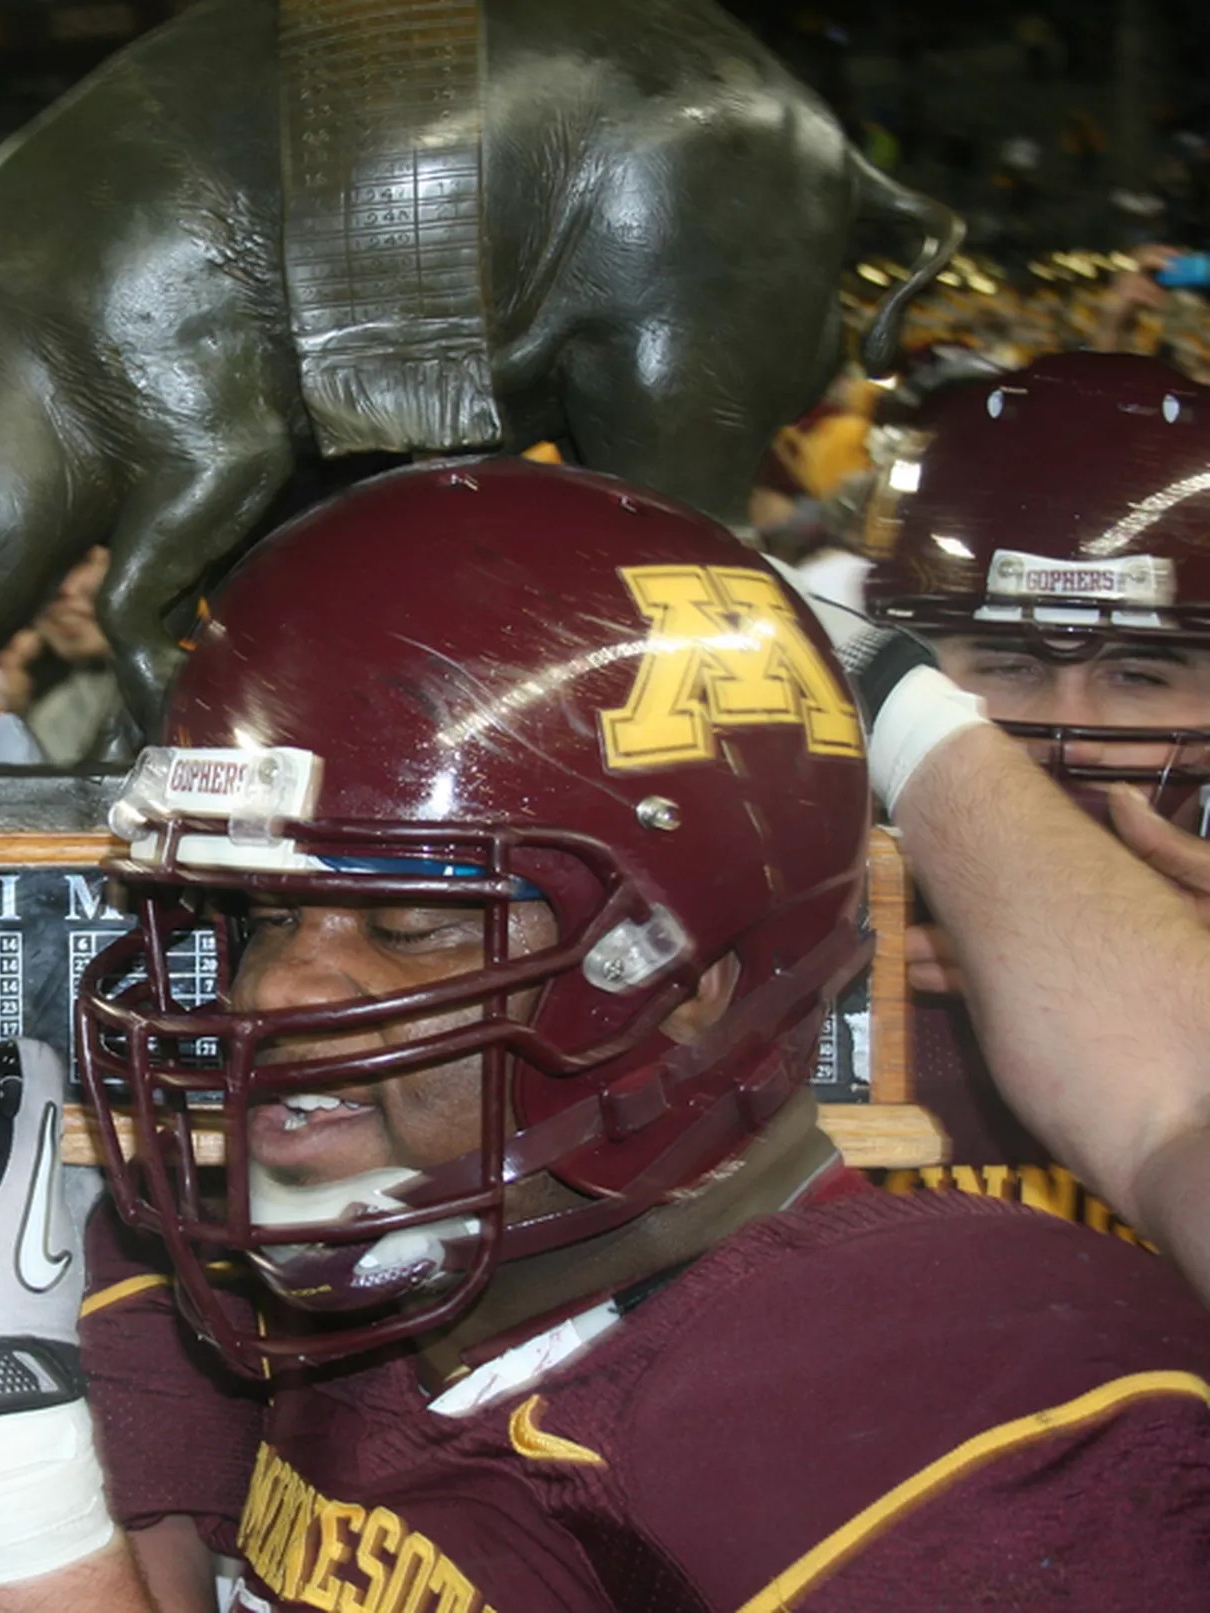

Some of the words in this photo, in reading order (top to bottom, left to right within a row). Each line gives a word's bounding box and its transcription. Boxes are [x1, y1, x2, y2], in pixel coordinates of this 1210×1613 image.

[1026, 568, 1116, 592] GOPHERS
[1, 938, 18, 951] 14
[1, 959, 18, 972] 14
[1, 981, 18, 993] 14
[1, 1002, 18, 1014] 23
[238, 1440, 497, 1613] MINNESOT
